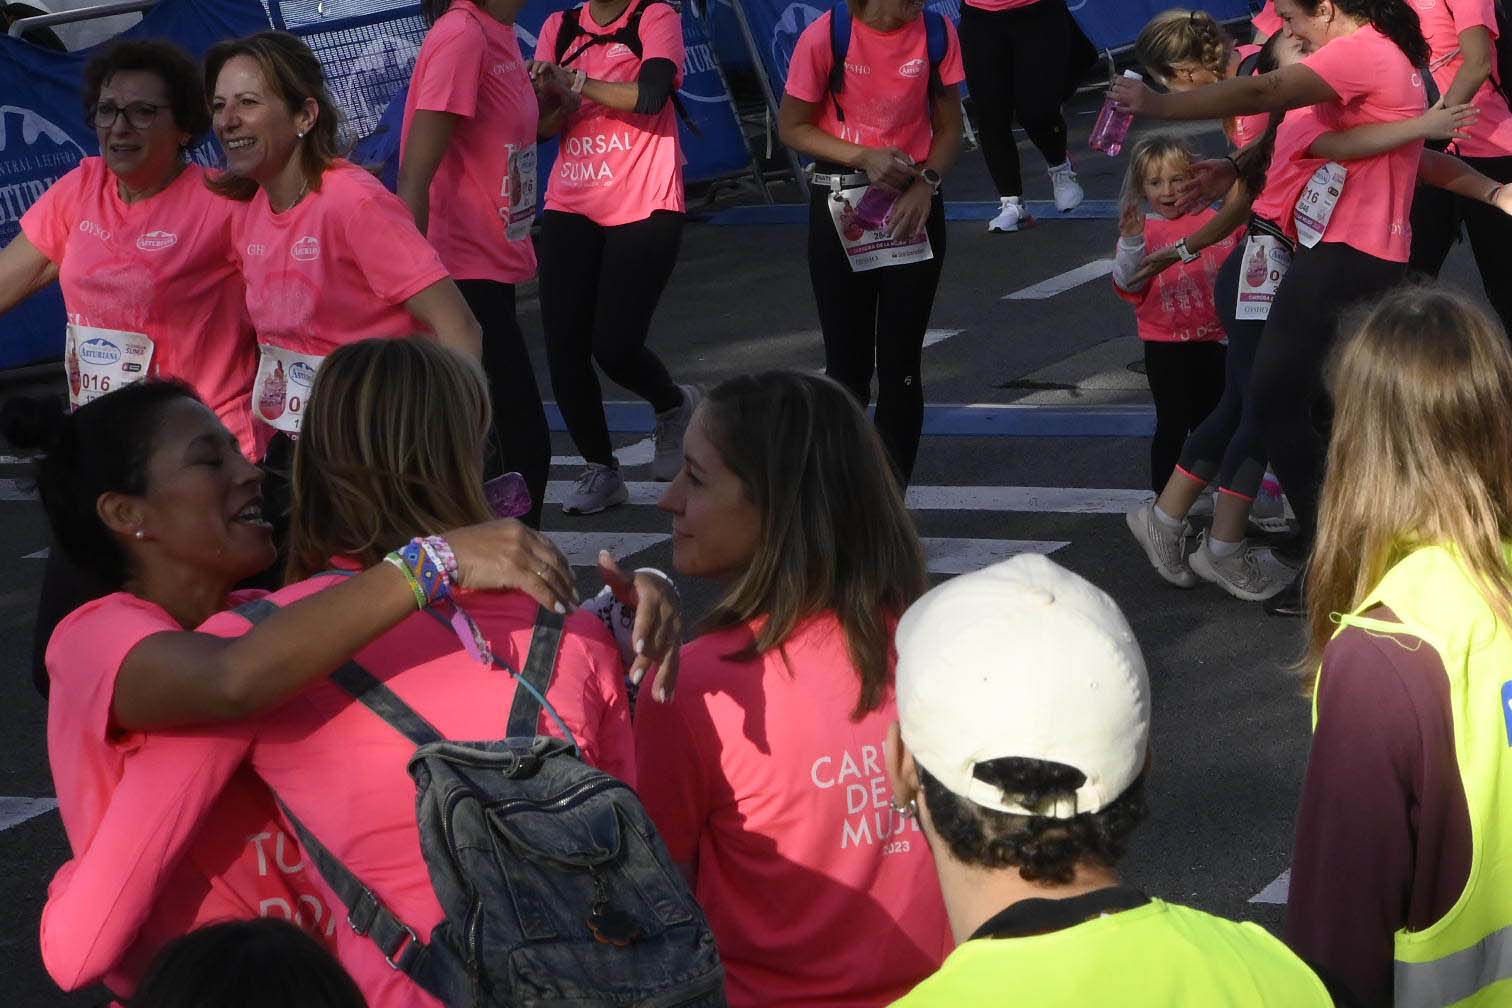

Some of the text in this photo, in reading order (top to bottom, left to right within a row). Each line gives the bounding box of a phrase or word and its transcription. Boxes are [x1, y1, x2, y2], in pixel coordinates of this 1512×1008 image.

[843, 62, 871, 76] YSHO
[560, 160, 614, 181] SUMA
[82, 373, 110, 391] 016
[847, 776, 888, 814] DE
[251, 831, 304, 876] TU
